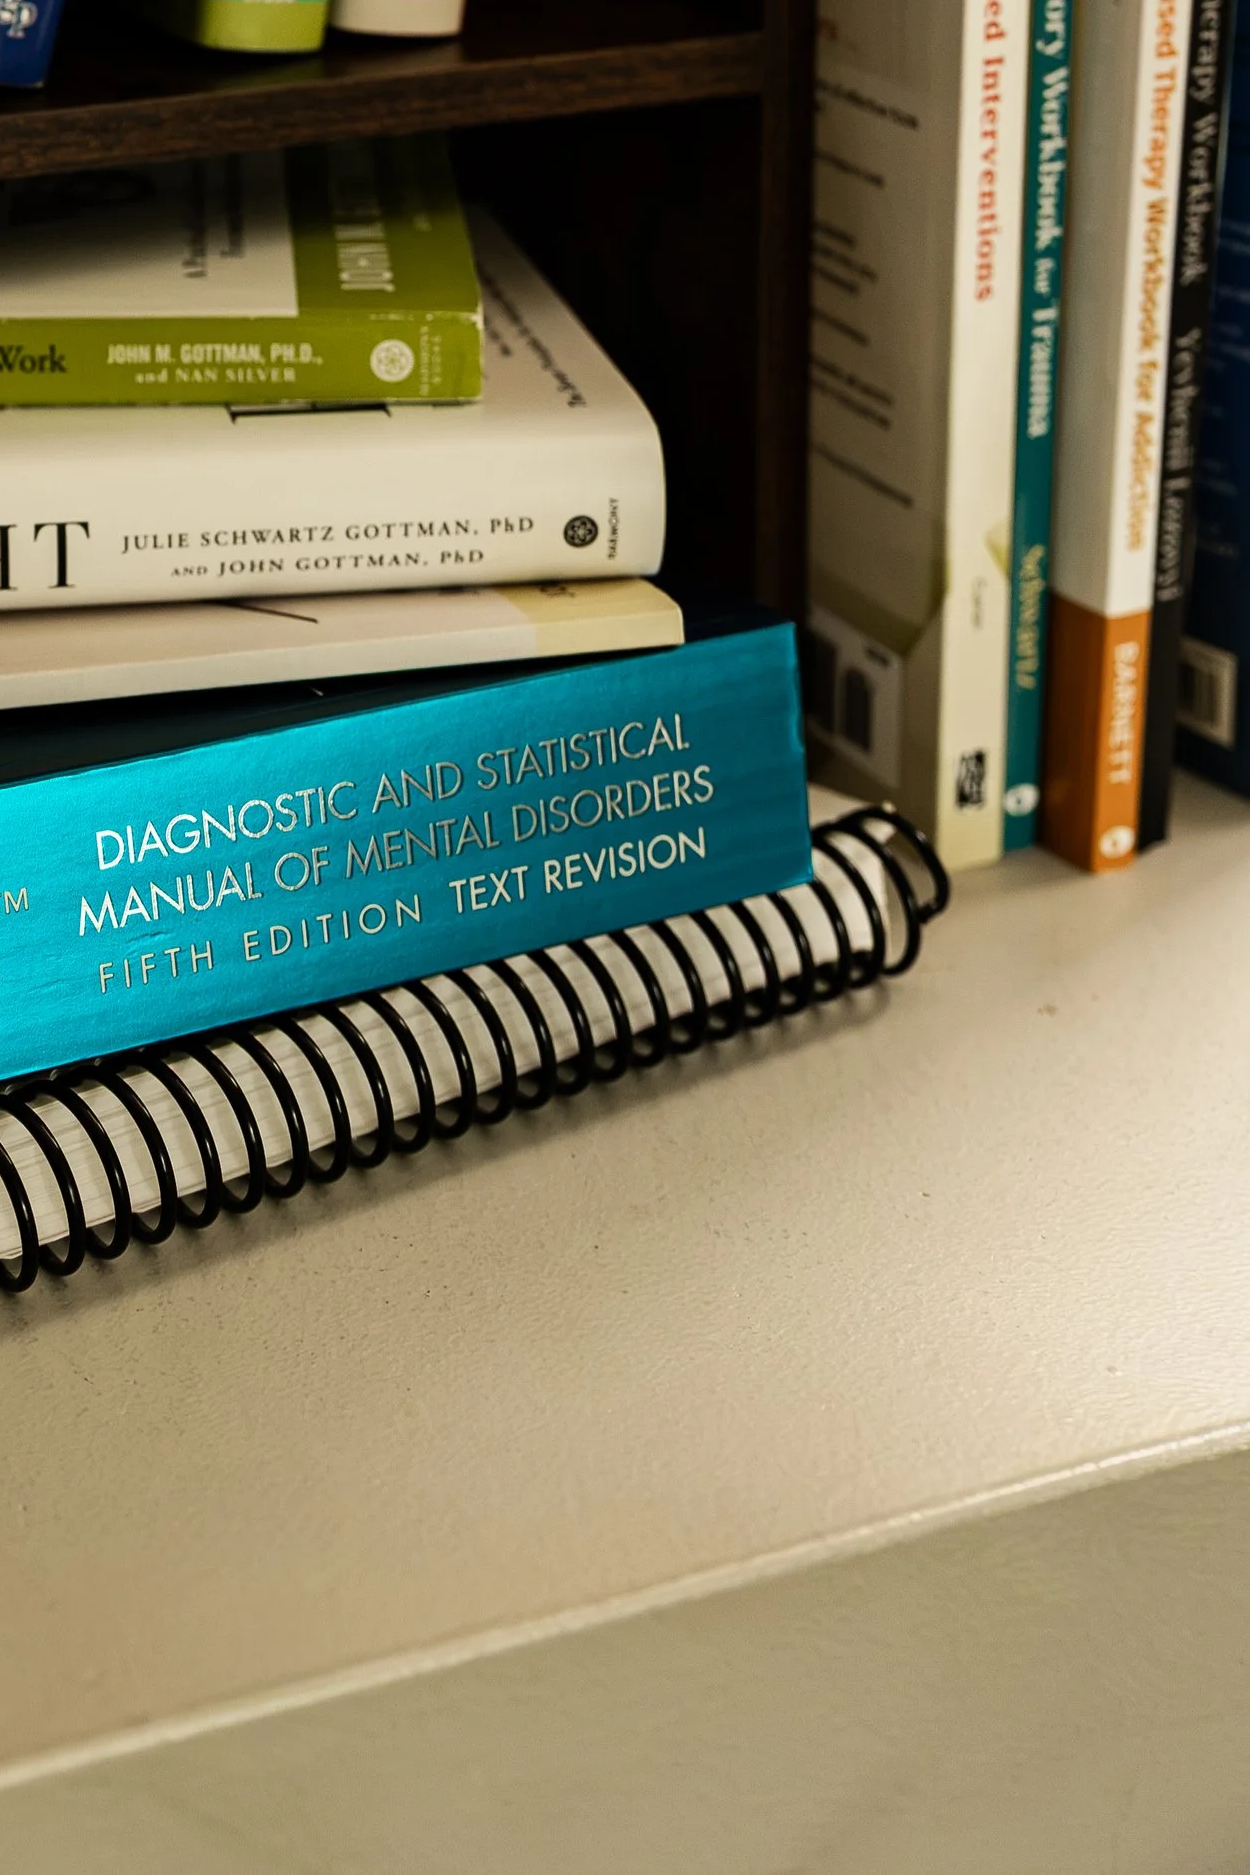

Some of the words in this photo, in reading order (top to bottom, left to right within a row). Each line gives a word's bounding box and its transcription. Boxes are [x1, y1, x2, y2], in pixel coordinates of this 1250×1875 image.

[975, 55, 1004, 303] Interventions
[1142, 67, 1179, 192] Therapy
[1178, 112, 1219, 287] Workbook
[1136, 198, 1171, 352] Workbook
[107, 344, 151, 365] JOHN
[154, 344, 175, 365] M.
[180, 343, 266, 366] GOTTMAN,
[135, 367, 169, 385] and
[175, 366, 220, 384] NAN
[225, 366, 297, 384] SILVER
[1026, 301, 1060, 440] Trauma
[120, 532, 192, 555] JULIE
[199, 525, 335, 551] SCHWARTZ
[345, 519, 479, 543] GOTTMAN,
[489, 515, 535, 535] PhD
[171, 563, 209, 578] AND
[216, 558, 286, 579] JOHN
[294, 551, 429, 574] GOTTMAN,
[438, 546, 485, 569] PhD
[78, 862, 262, 937] MANUAL
[274, 843, 330, 892] OF
[345, 814, 500, 880] MENTAL
[512, 765, 715, 841] DISORDERS
[95, 780, 358, 871] DIAGNOSTIC
[372, 762, 463, 815] AND
[477, 713, 690, 787] STATISTICAL
[100, 940, 215, 994] FIFTH
[243, 894, 422, 963] EDITION
[448, 867, 530, 915] TEXT
[545, 826, 708, 895] REVISION
